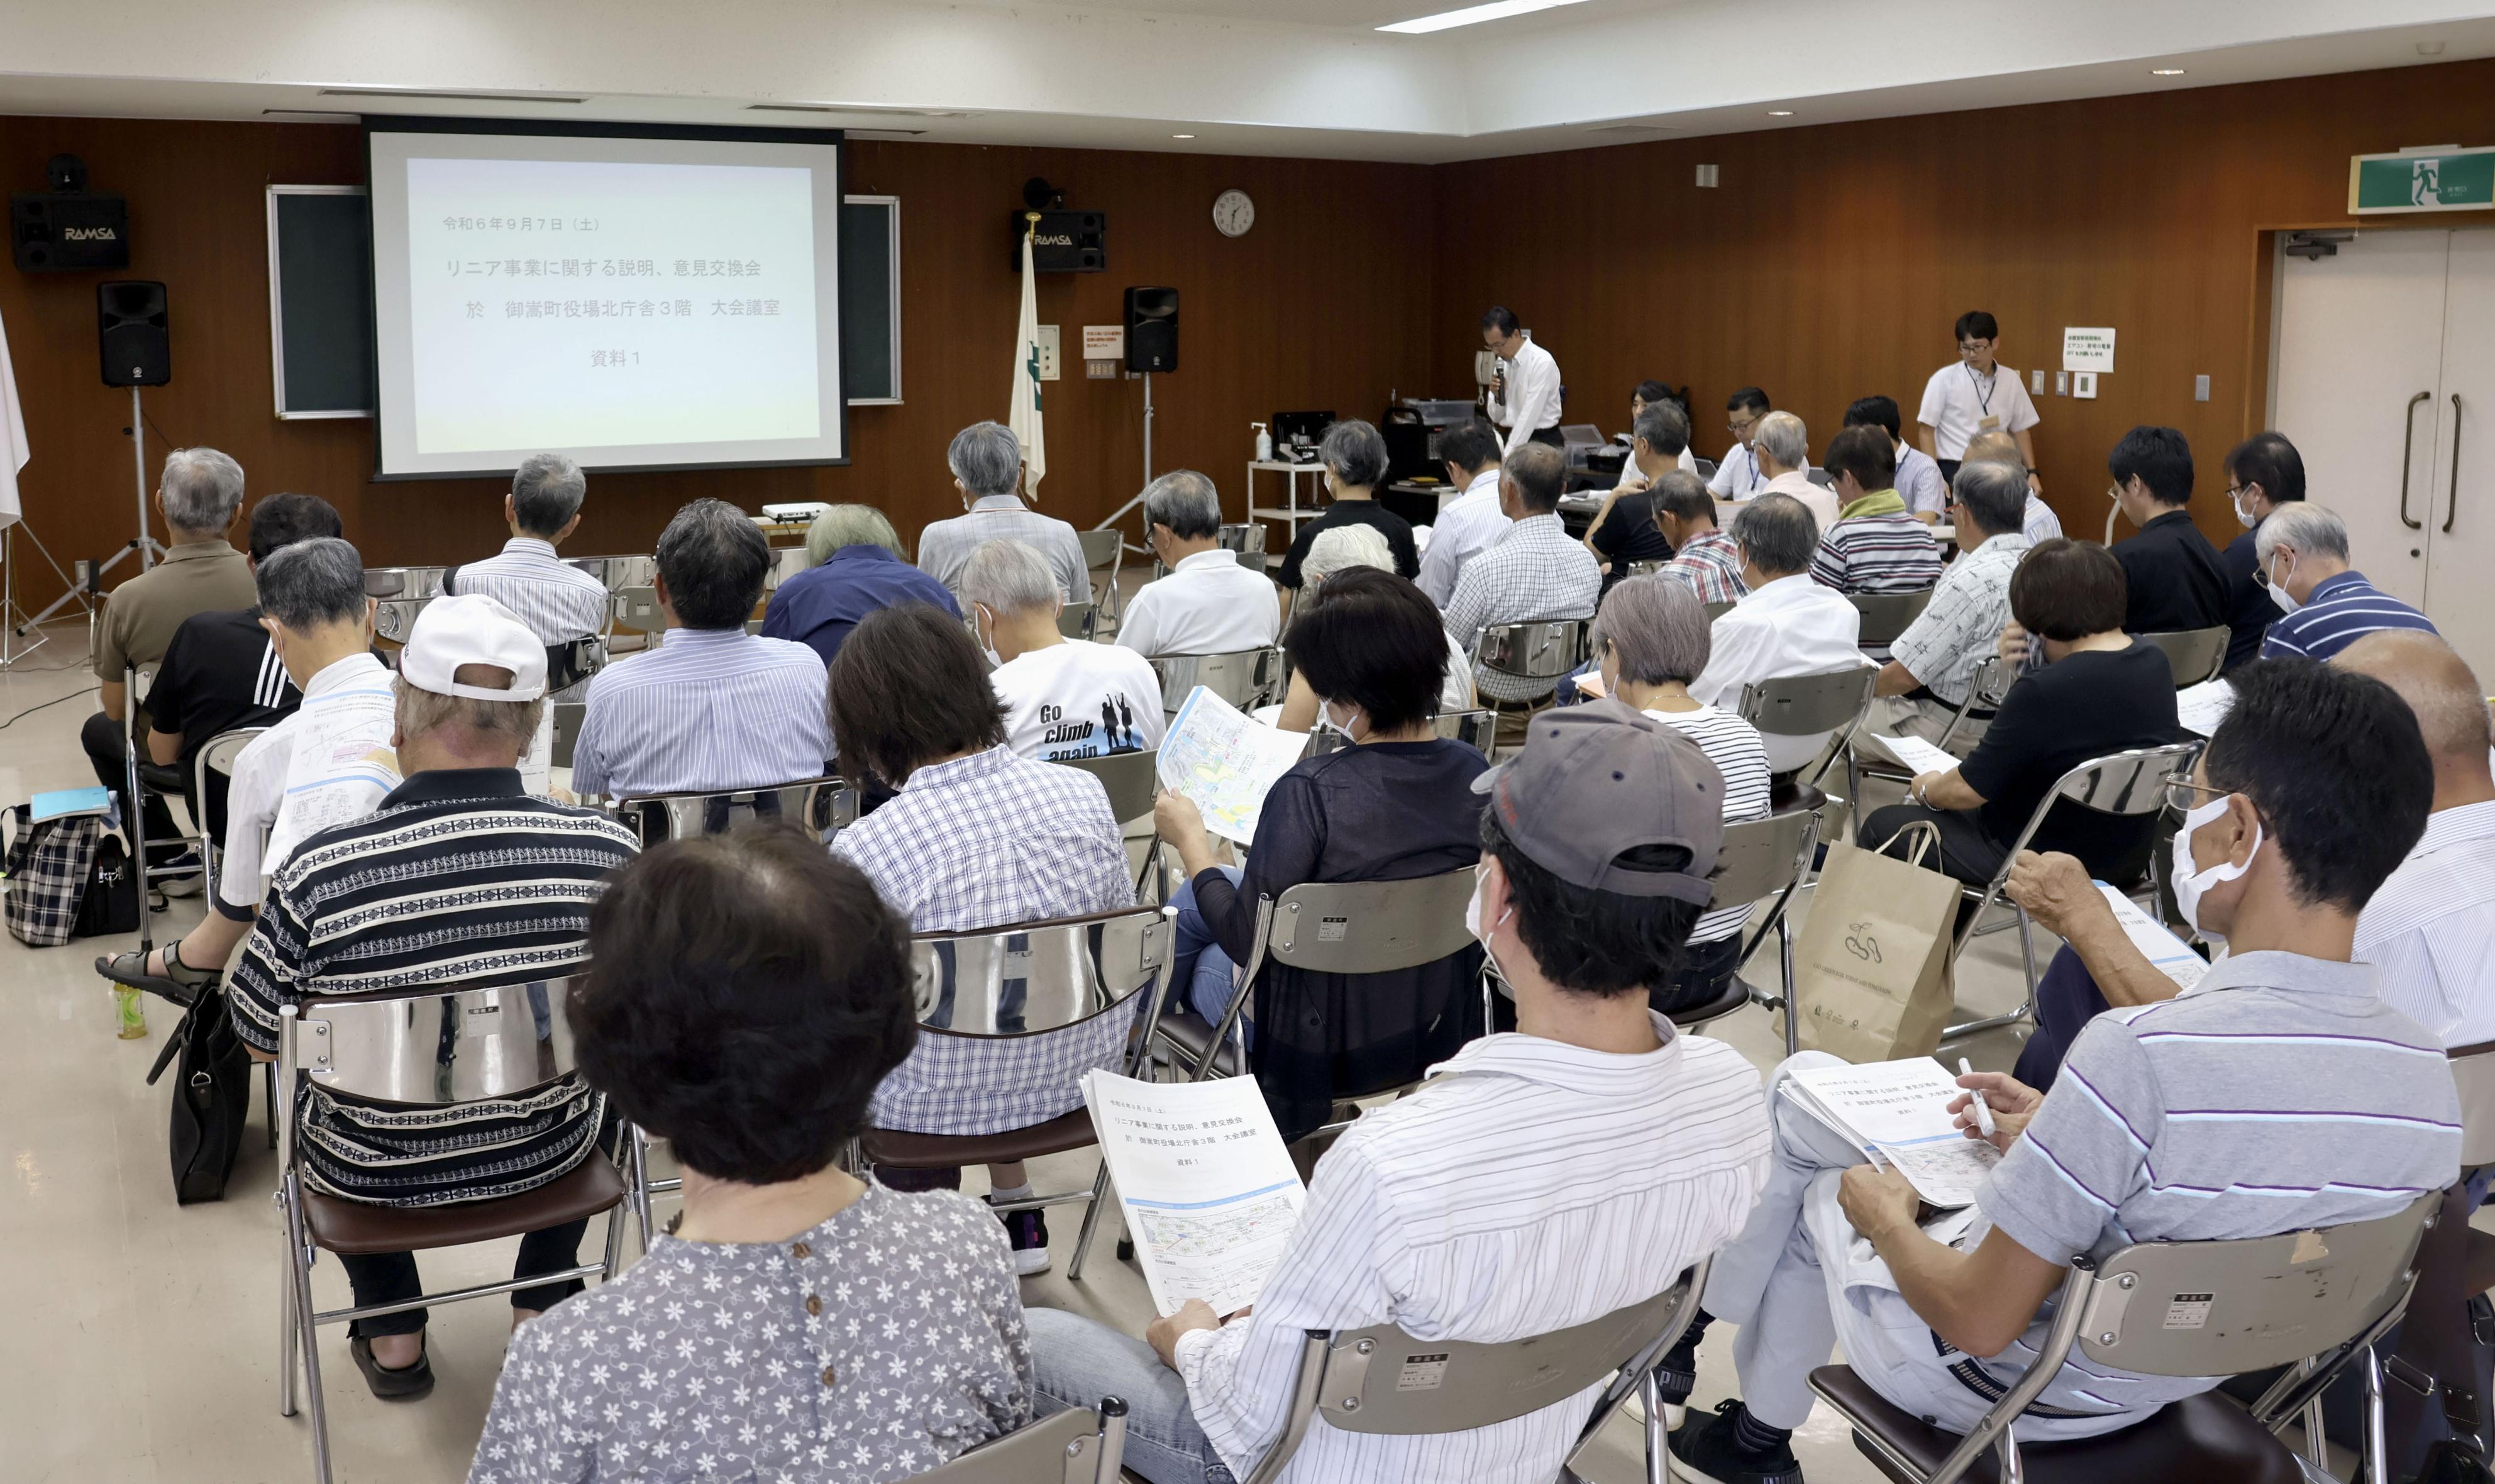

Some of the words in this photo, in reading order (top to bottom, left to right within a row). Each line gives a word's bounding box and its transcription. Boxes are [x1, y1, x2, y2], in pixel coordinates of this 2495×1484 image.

[65, 227, 116, 240] RAMSA
[1034, 234, 1073, 245] RAMSA
[447, 258, 761, 277] リニア事業に関する説明、意見交換会
[466, 300, 484, 318] 於
[711, 298, 781, 316] 大会議室
[591, 349, 640, 367] 資料１
[1040, 704, 1062, 724] Go
[1044, 721, 1094, 744] climb
